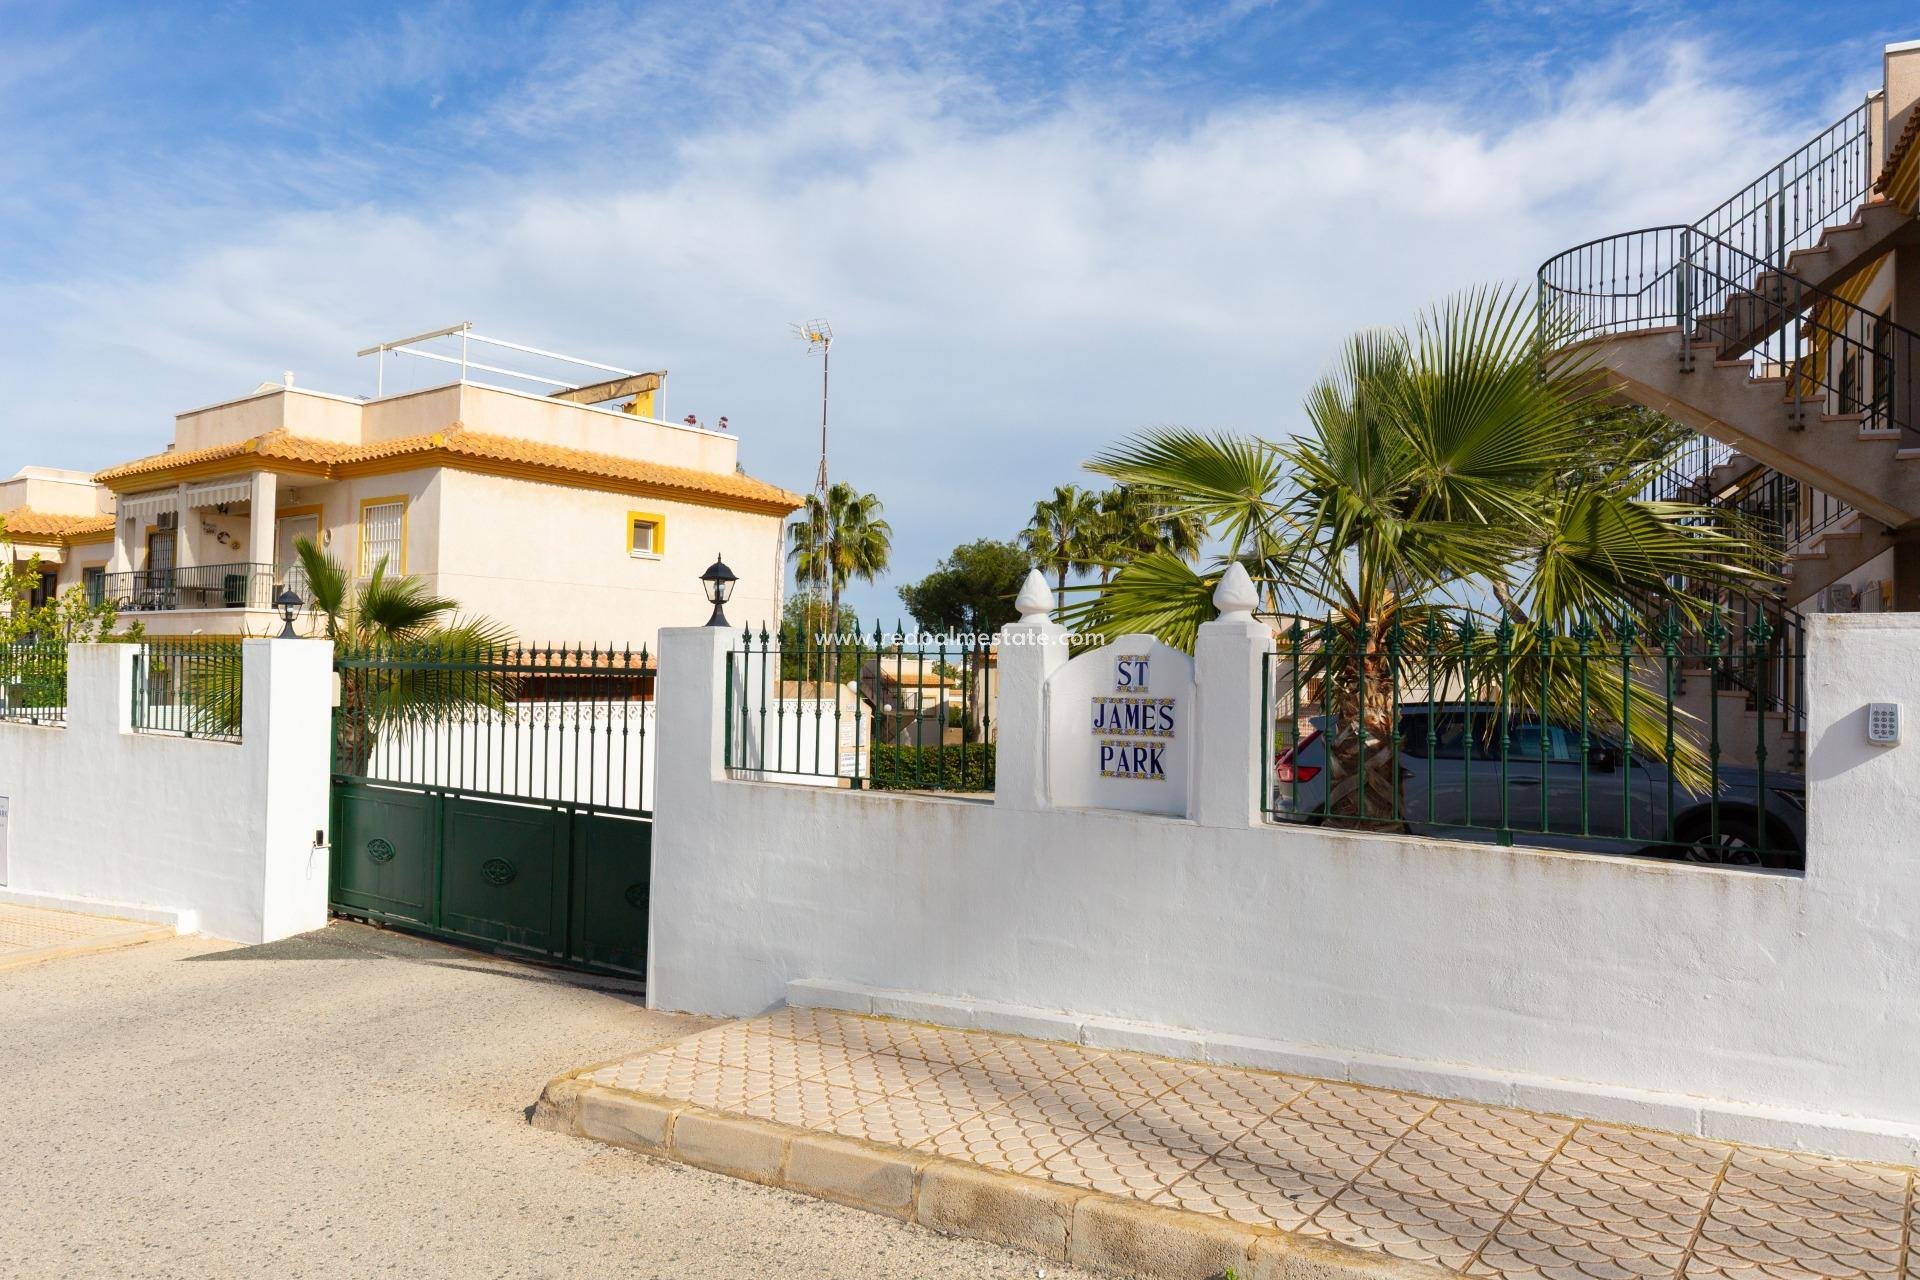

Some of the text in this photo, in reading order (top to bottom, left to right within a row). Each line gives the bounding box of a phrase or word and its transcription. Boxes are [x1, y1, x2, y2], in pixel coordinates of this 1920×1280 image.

[1117, 661, 1149, 686] ST
[1093, 703, 1175, 731] JAMES
[1100, 745, 1165, 774] PARK
